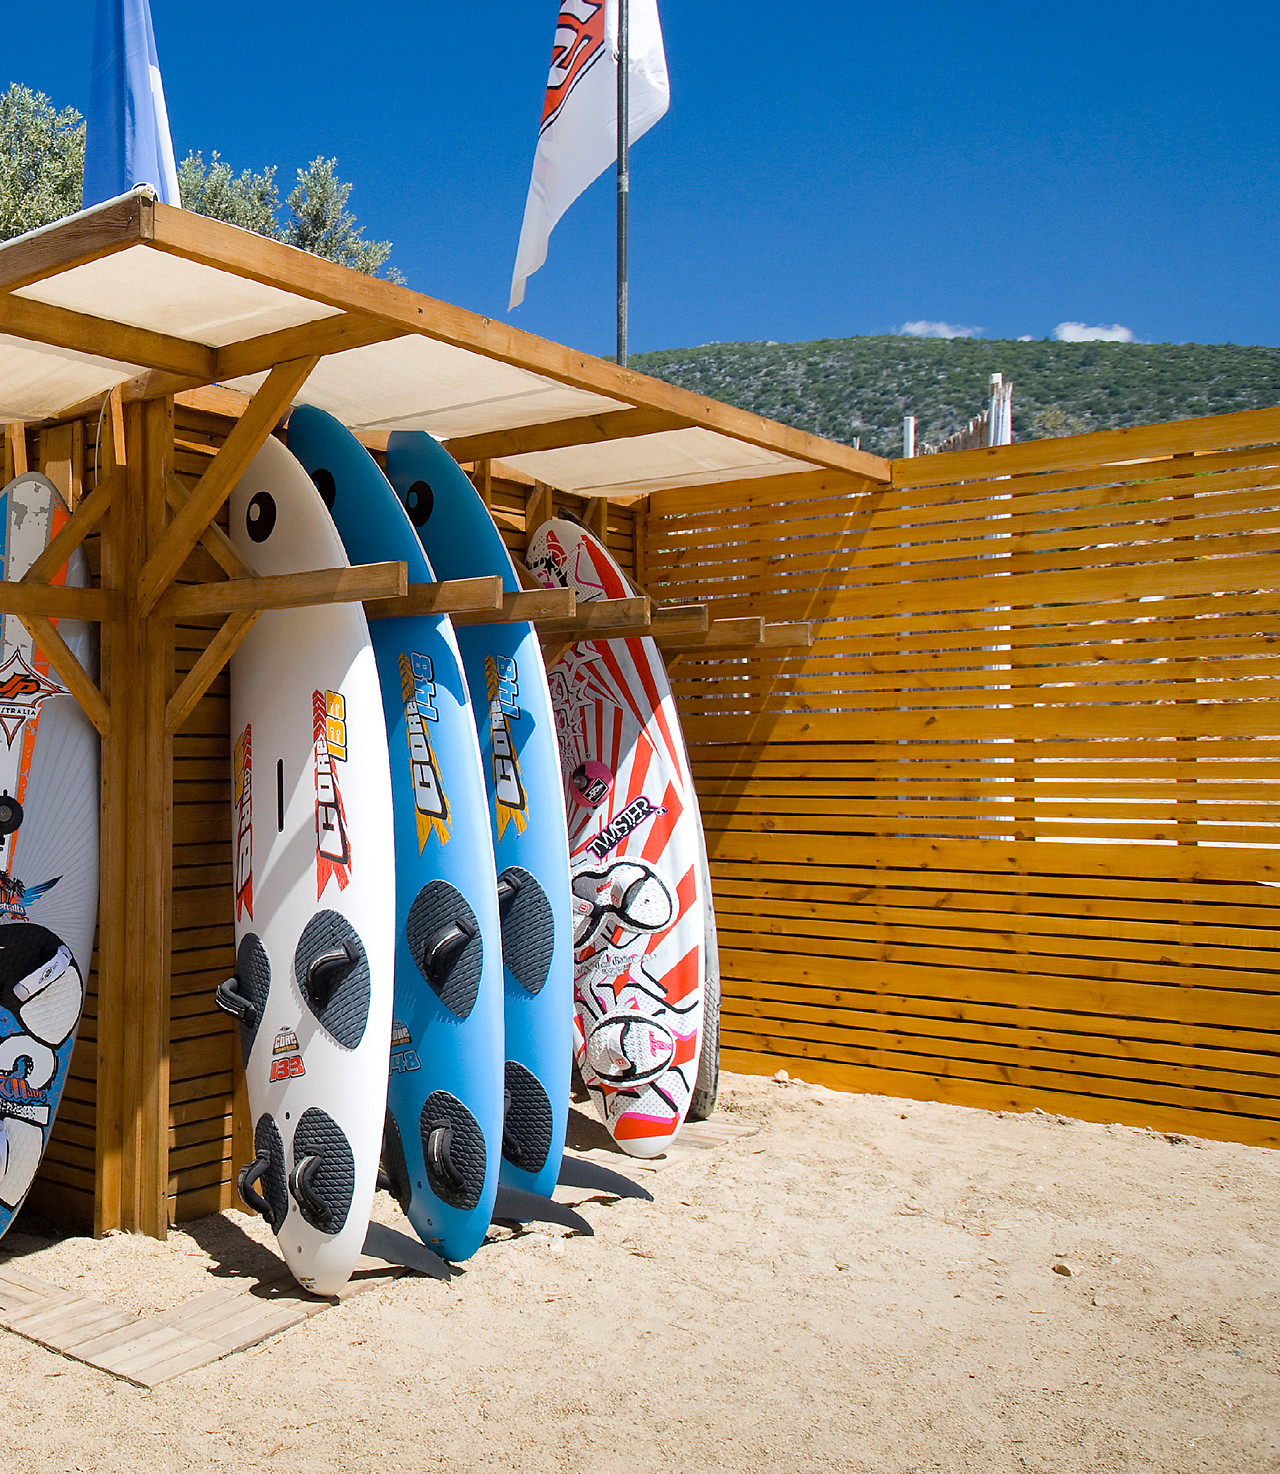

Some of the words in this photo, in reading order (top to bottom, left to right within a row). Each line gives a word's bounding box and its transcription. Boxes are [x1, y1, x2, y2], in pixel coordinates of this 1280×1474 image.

[411, 652, 439, 721] 148
[496, 654, 518, 720] 148
[325, 689, 347, 762] 133
[586, 797, 655, 857] TWISTER
[270, 1055, 306, 1082] 133
